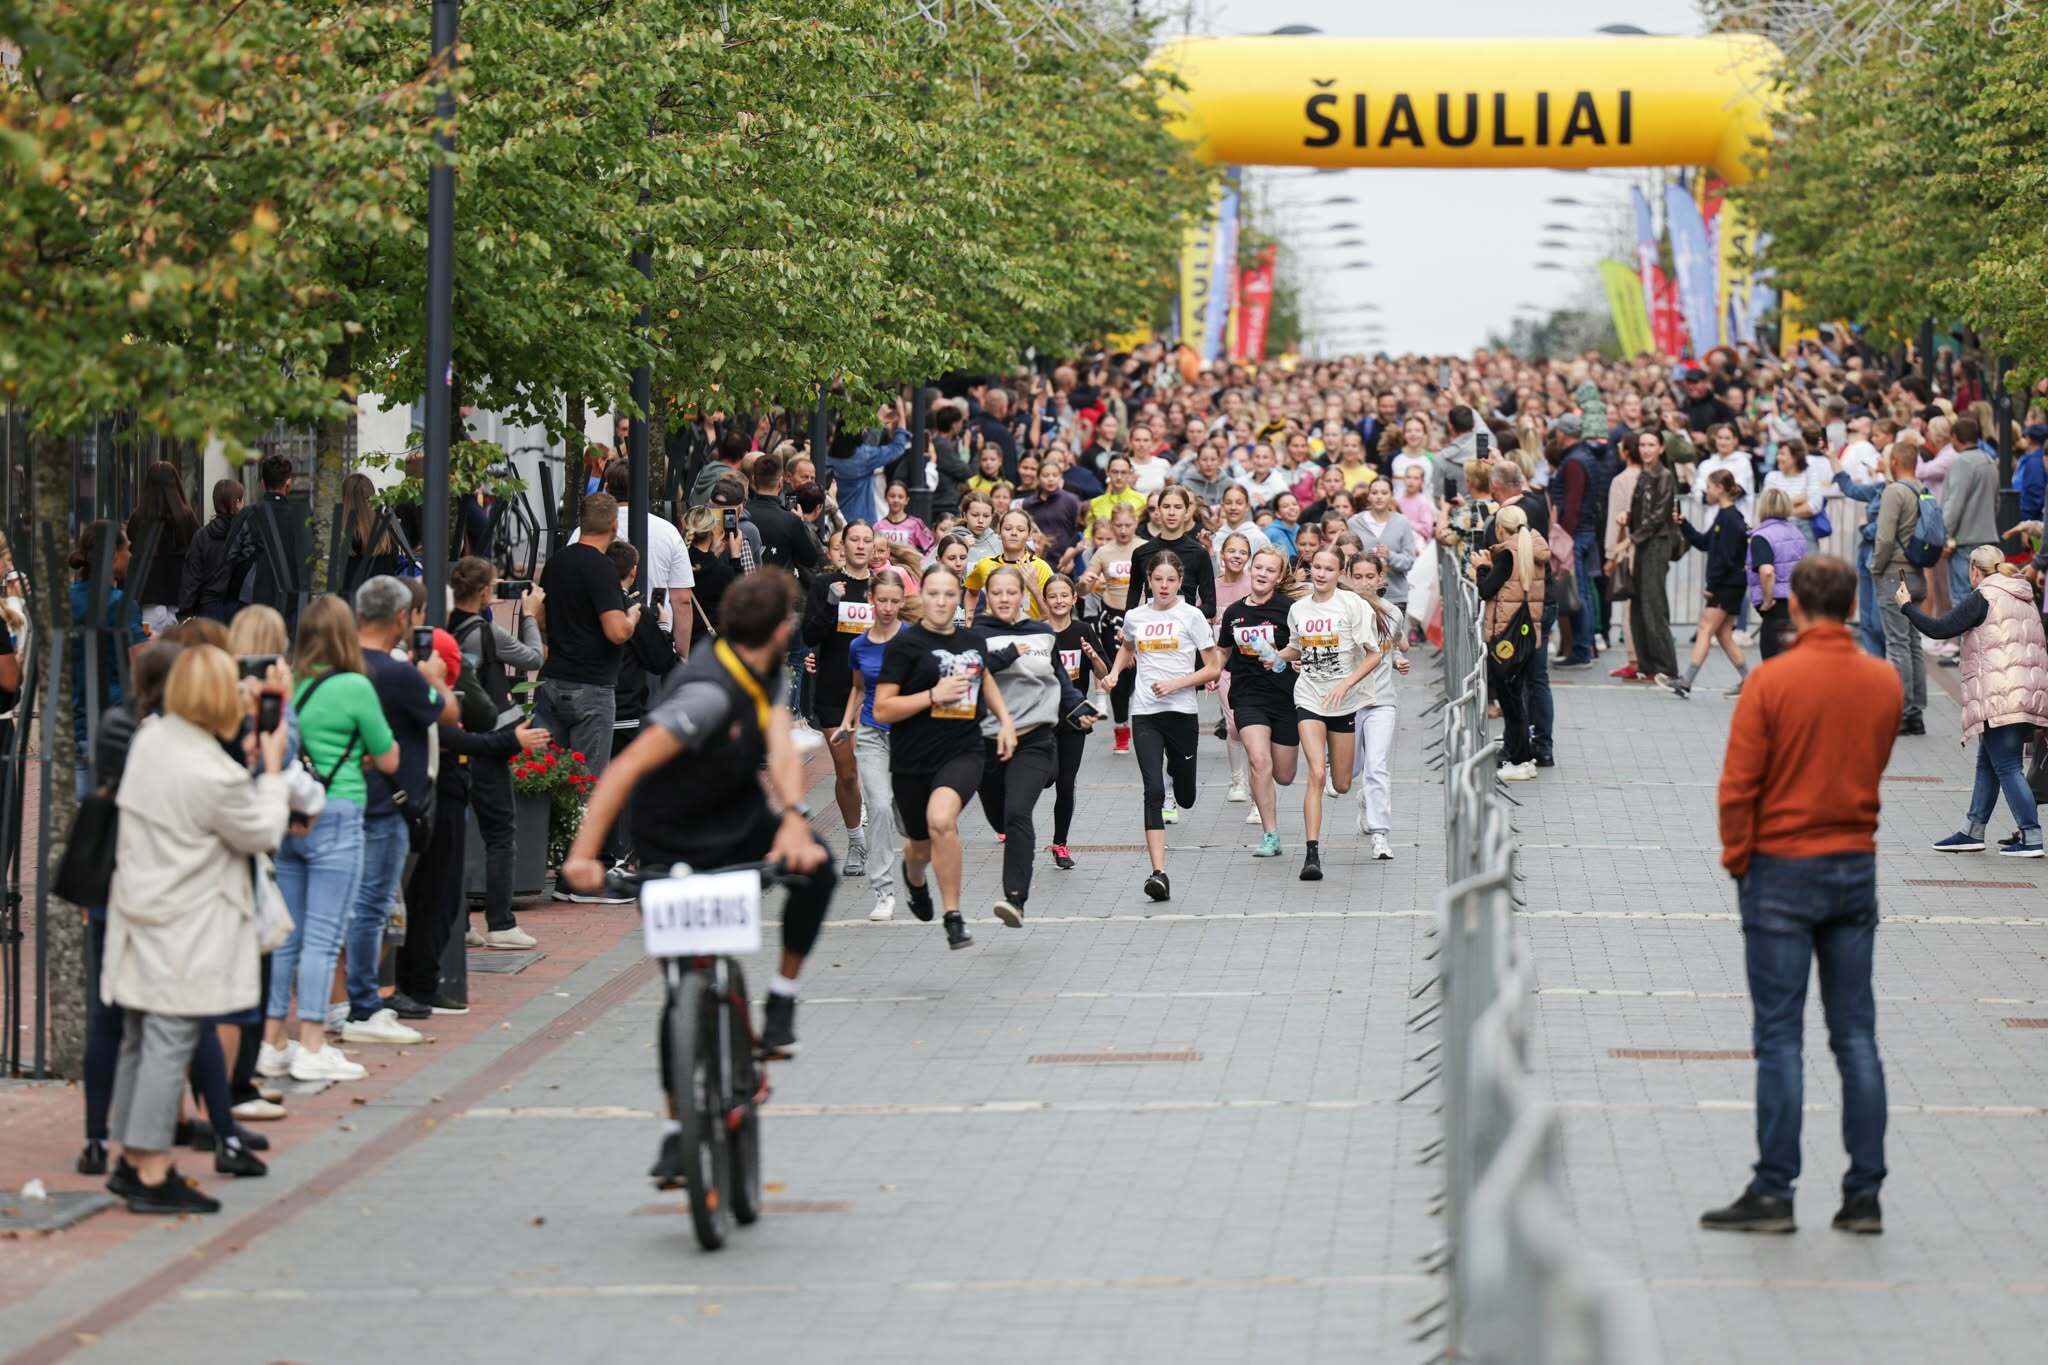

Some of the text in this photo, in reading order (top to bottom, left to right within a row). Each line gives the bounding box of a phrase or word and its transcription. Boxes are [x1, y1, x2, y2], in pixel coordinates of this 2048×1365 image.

[1303, 78, 1632, 148] ŠIAULIAI
[1145, 622, 1173, 637] 001
[1305, 617, 1332, 633] 001
